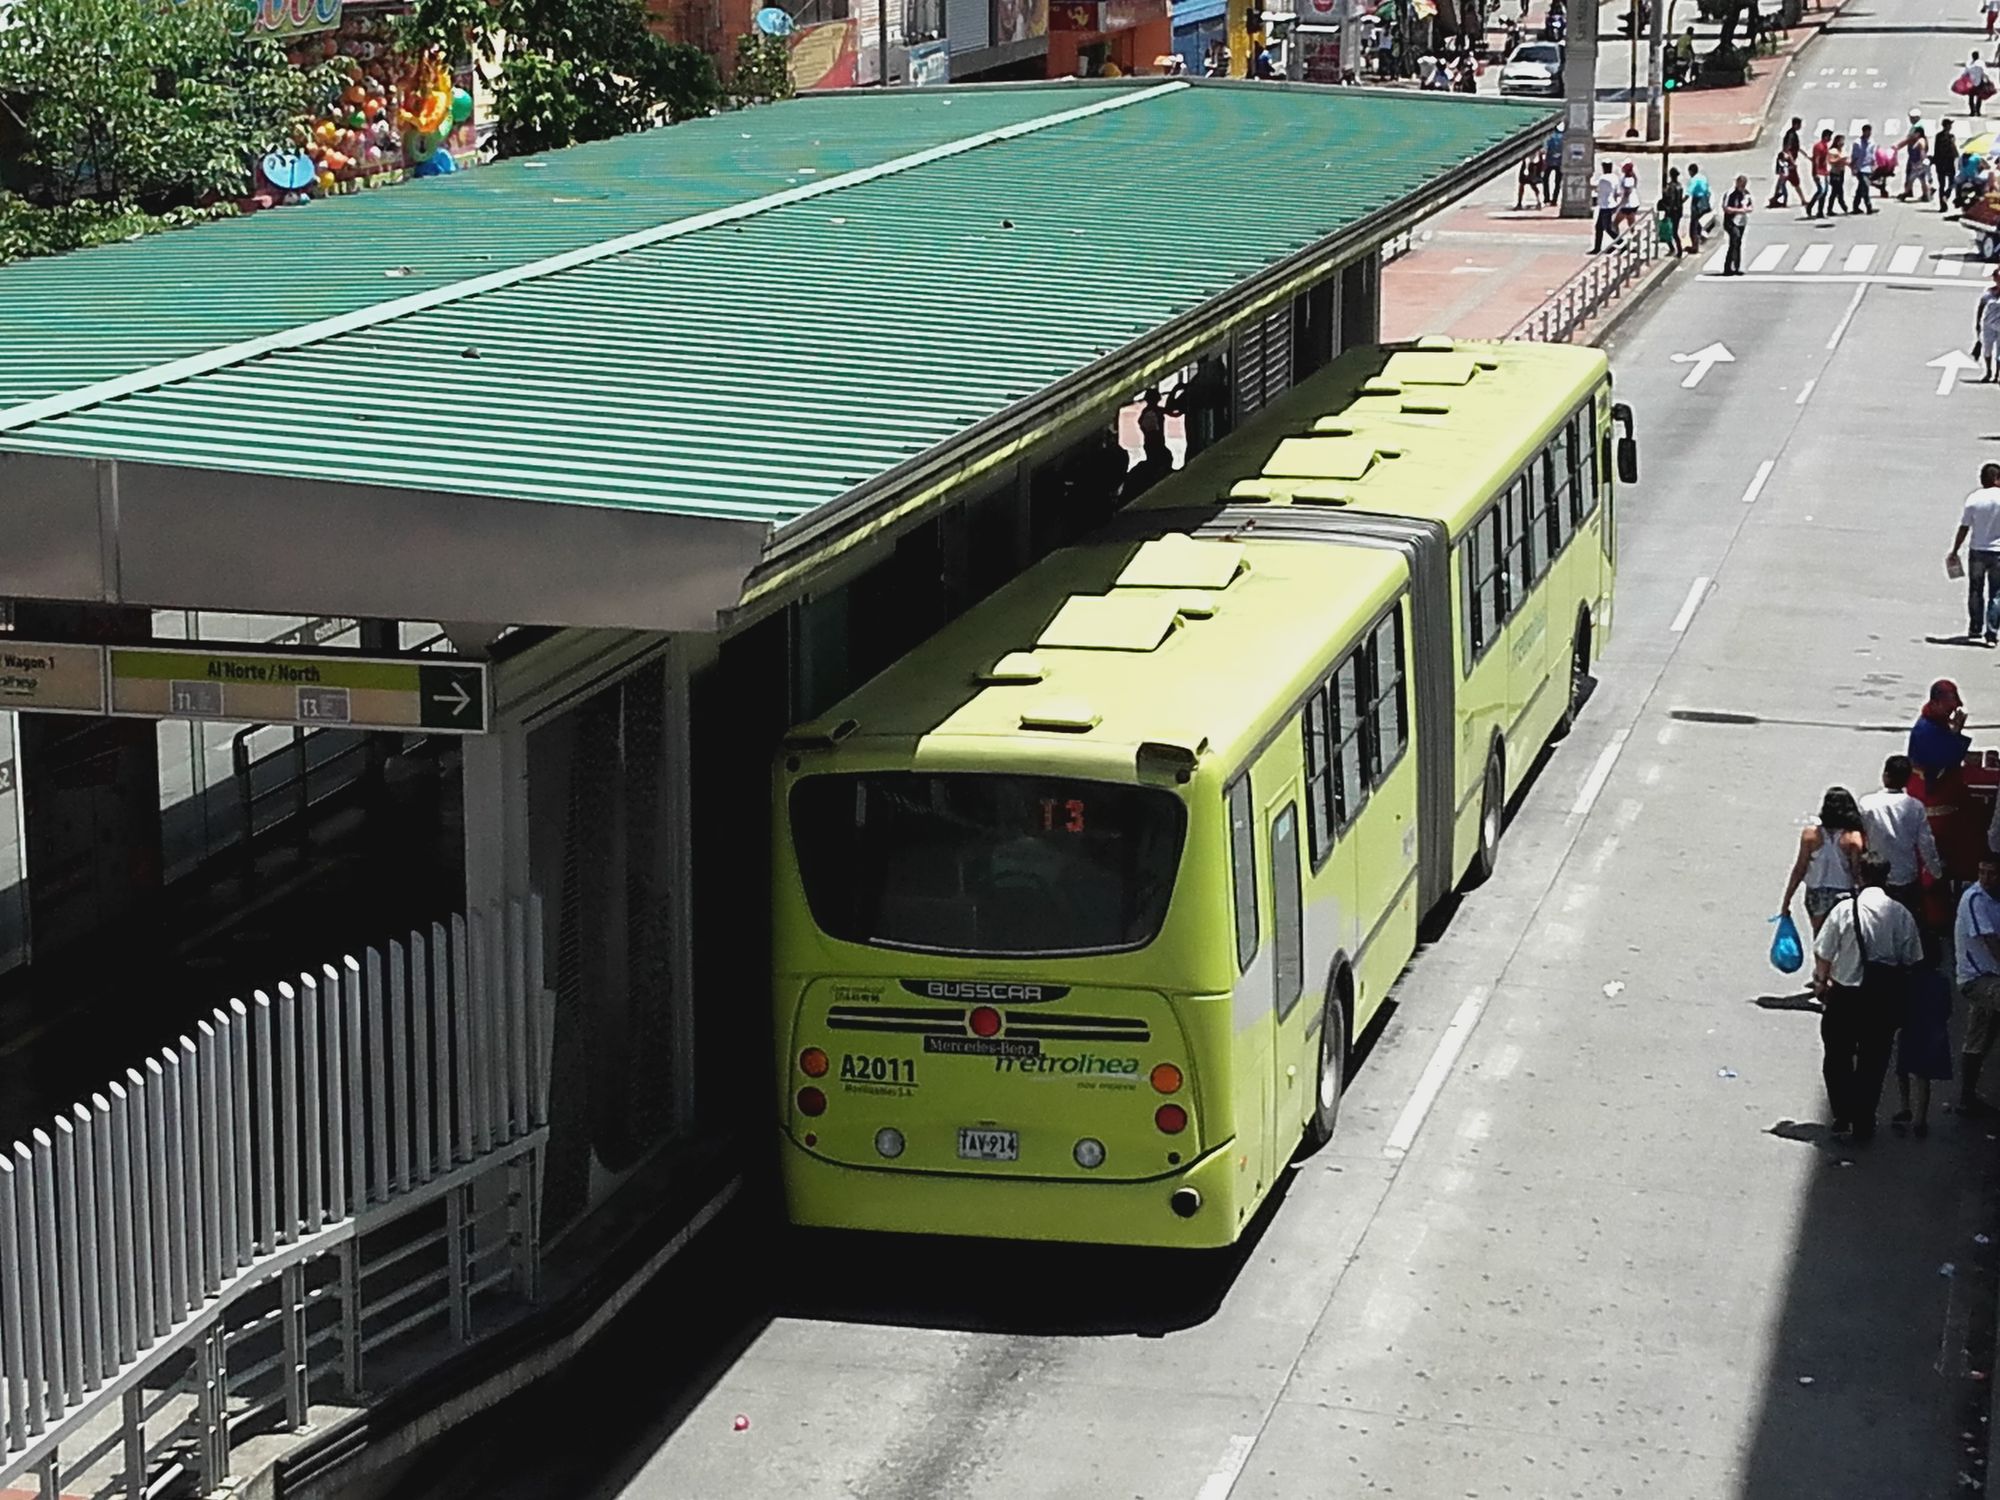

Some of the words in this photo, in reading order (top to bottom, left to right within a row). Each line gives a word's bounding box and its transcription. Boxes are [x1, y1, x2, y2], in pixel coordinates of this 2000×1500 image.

[4, 654, 46, 671] Wagon
[207, 661, 222, 676] Al
[224, 662, 266, 679] Norte
[279, 665, 321, 682] North
[927, 981, 1042, 1000] BUSSCAR
[929, 1037, 1035, 1056] Mercedes-Benz
[841, 1054, 915, 1082] A2011
